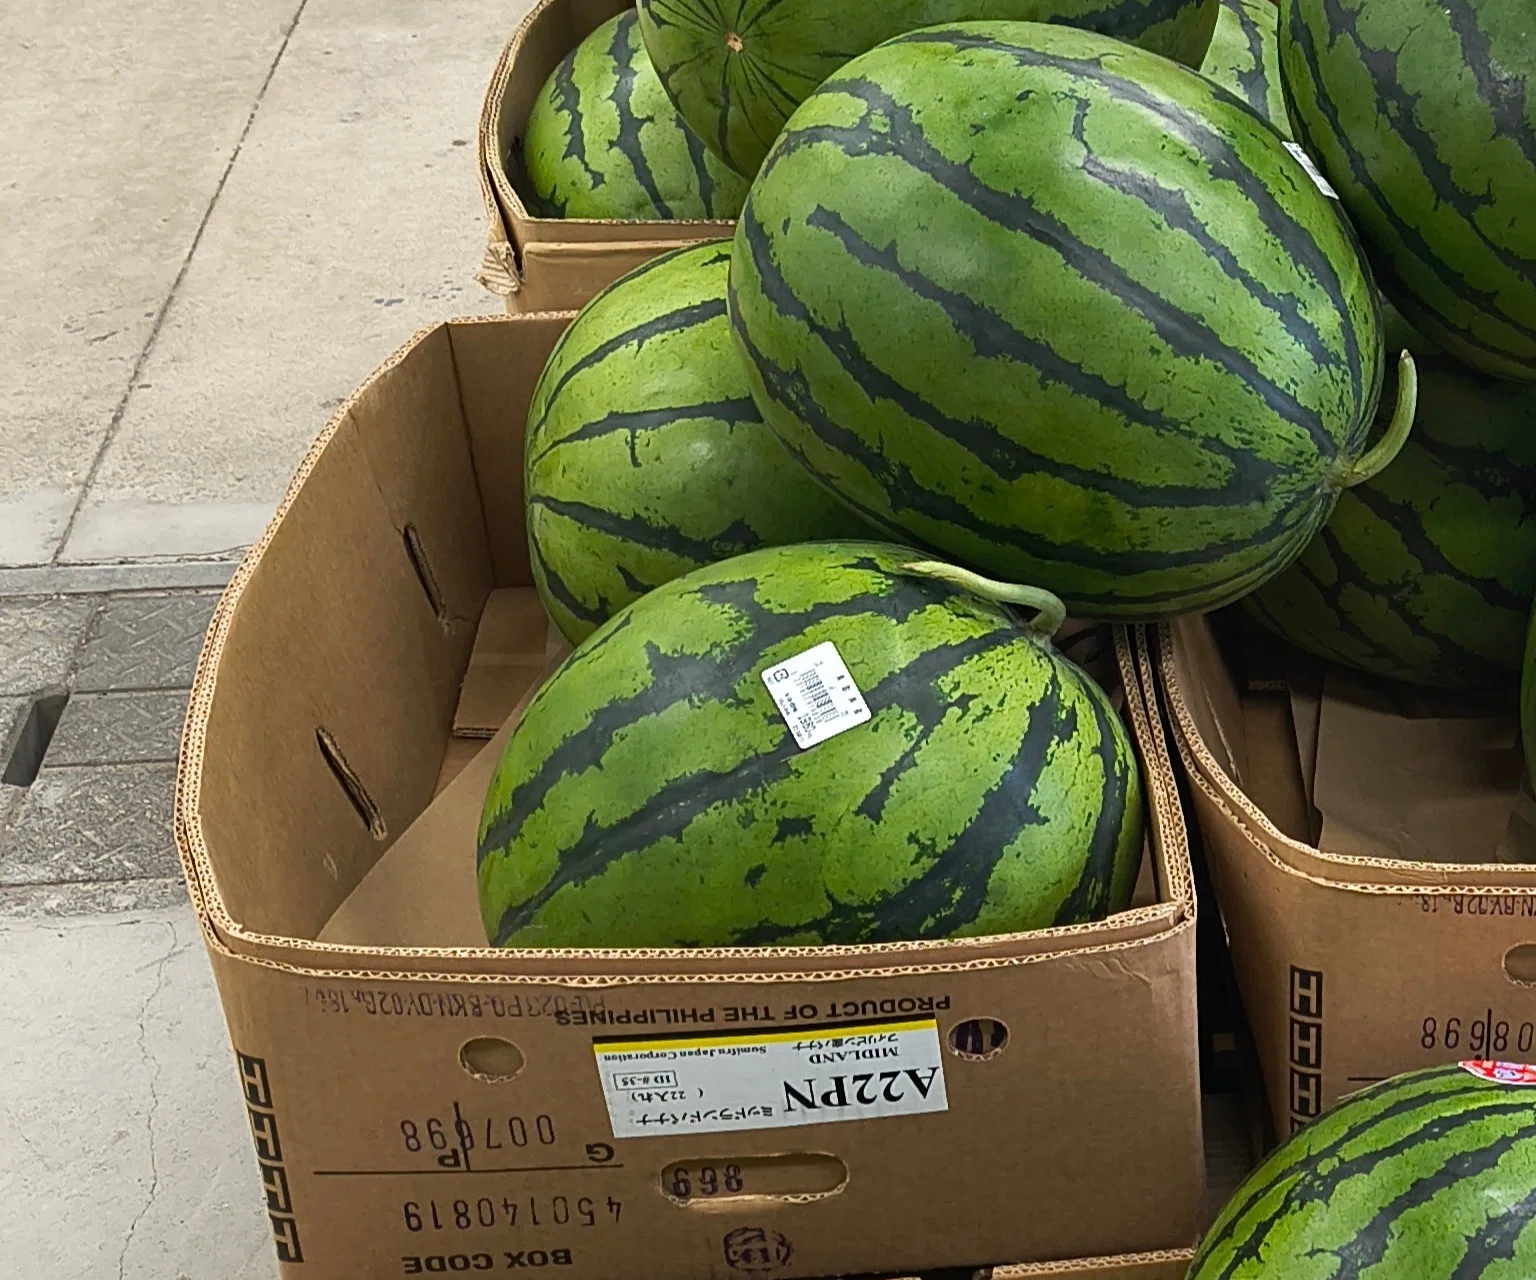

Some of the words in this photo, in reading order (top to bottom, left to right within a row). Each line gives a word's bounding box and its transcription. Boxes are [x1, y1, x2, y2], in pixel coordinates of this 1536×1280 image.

[554, 1004, 715, 1026] PHILIPPINES
[724, 1007, 772, 1022] THE
[784, 1005, 818, 1021] OF
[826, 996, 951, 1020] PRODUCT
[718, 1046, 766, 1058] Sumifru
[792, 1034, 899, 1051] フィリピン産バナナ
[604, 1052, 677, 1063] Corporation
[679, 1049, 716, 1060] Japan
[809, 1046, 899, 1065] MIDLAND
[653, 1075, 672, 1087] ID
[782, 1067, 940, 1113] A22PN
[635, 1106, 773, 1125] ミッドランドバナナ
[400, 1114, 556, 1152] 007698
[438, 1149, 460, 1168] P
[585, 1143, 614, 1164] G
[403, 1196, 623, 1233] 450140819
[401, 1252, 494, 1275] CODE
[503, 1249, 572, 1267] BOX
